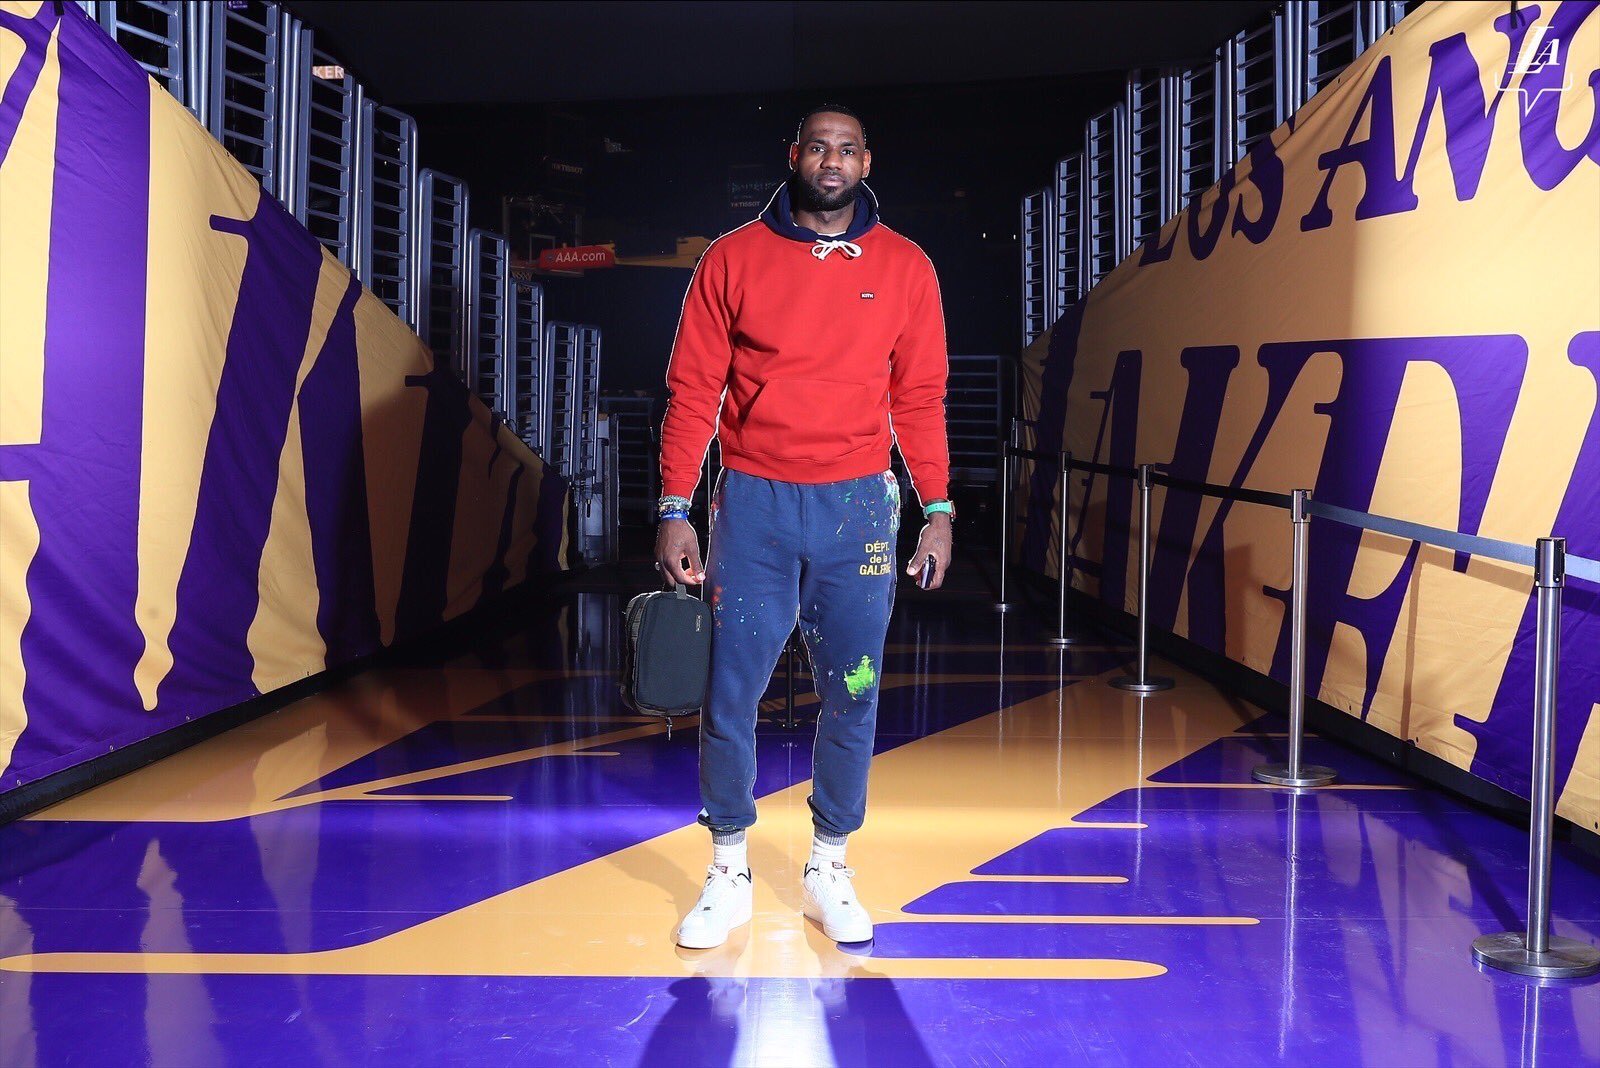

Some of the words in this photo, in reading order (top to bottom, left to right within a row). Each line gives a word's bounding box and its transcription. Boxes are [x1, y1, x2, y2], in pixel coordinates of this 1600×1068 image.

[555, 251, 606, 263] AAA.com
[865, 540, 890, 553] DÉPT.
[870, 554, 882, 564] de
